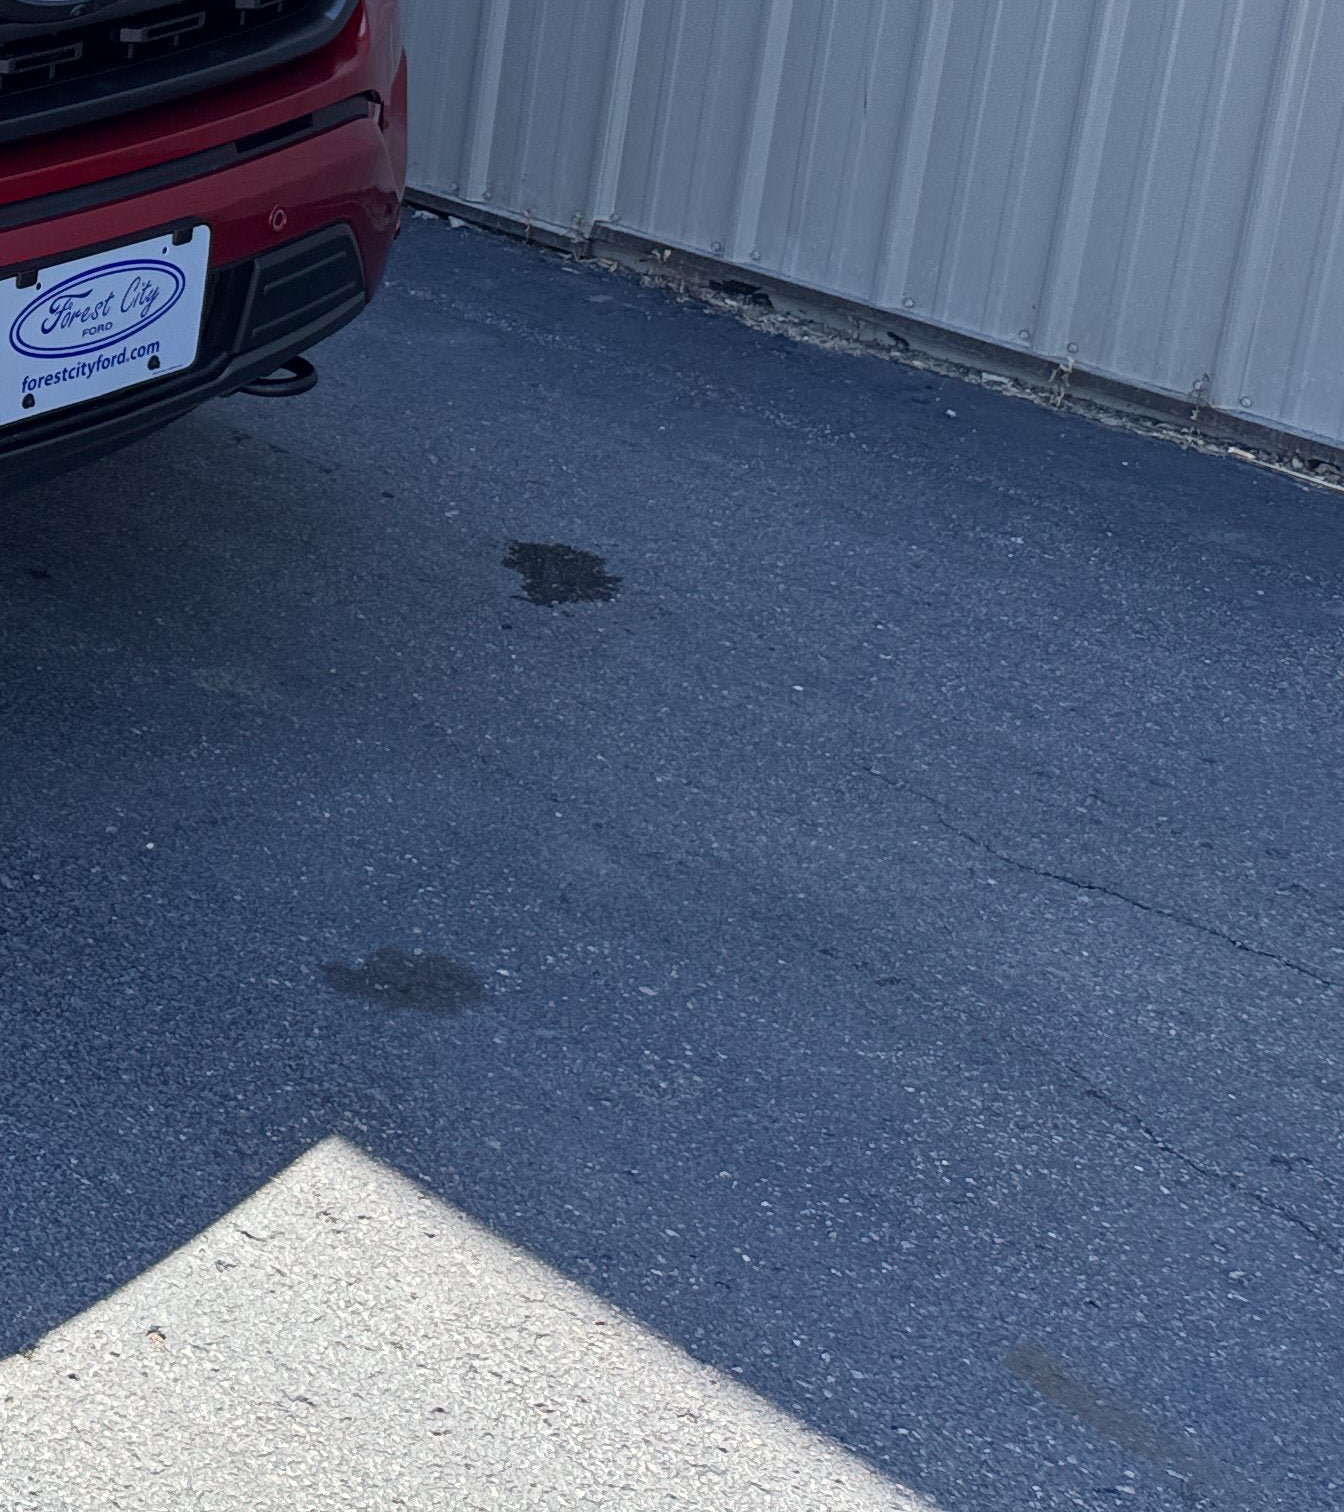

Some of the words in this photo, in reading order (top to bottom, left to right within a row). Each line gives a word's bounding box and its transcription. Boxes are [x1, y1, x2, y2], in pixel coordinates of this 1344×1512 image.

[40, 289, 115, 335] Forest
[120, 276, 160, 319] City
[82, 321, 113, 337] FORD
[21, 340, 160, 394] forestcityford.com
